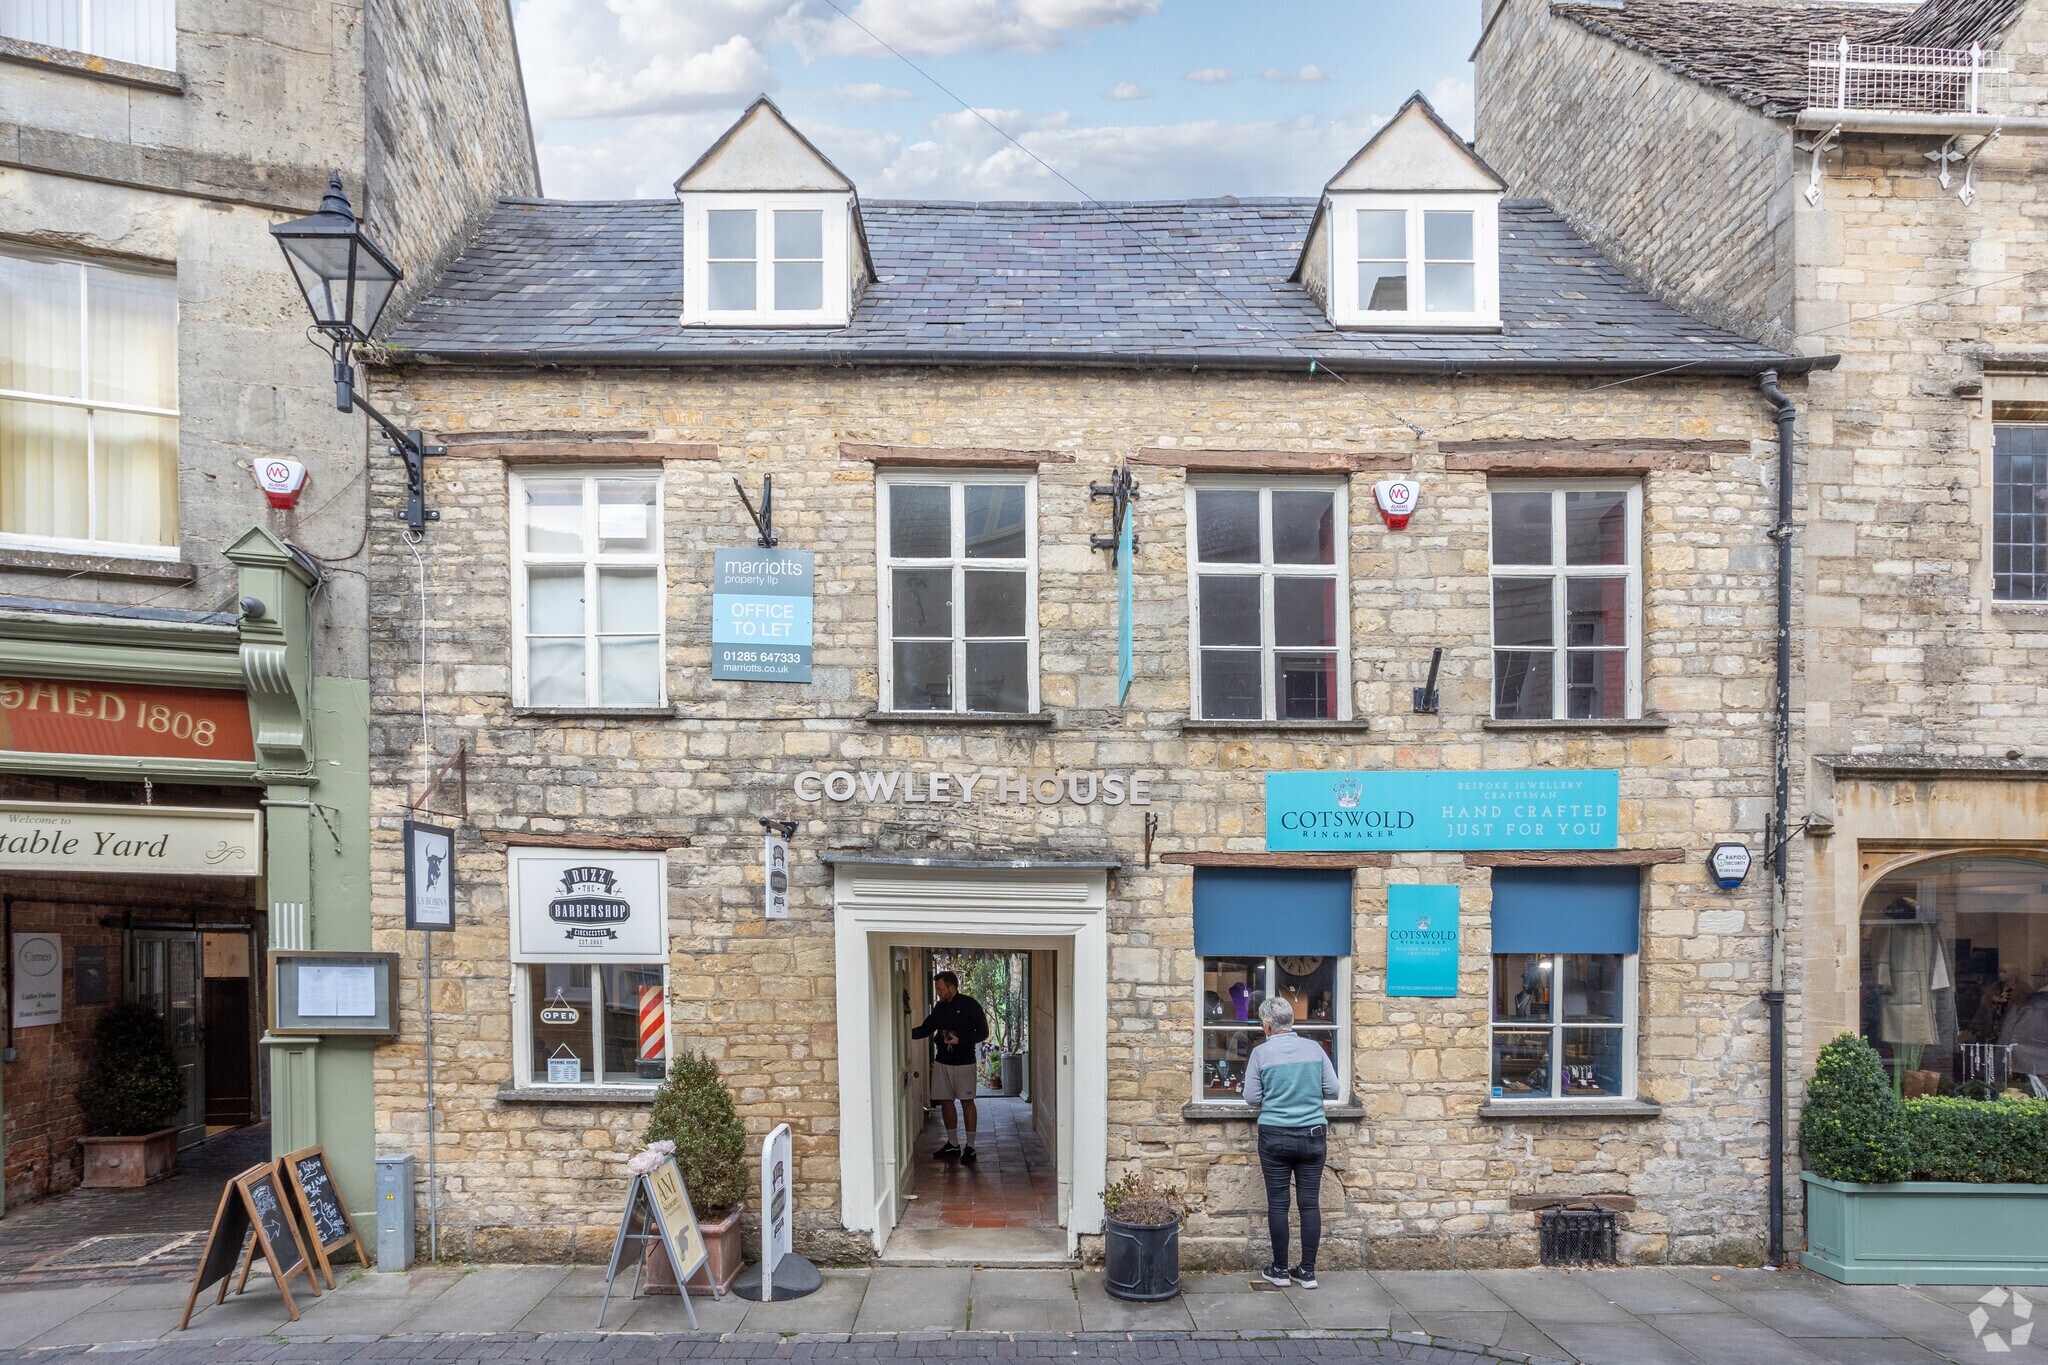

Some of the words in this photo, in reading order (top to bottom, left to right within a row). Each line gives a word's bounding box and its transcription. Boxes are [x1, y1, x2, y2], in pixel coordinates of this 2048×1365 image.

[725, 558, 803, 576] marriotts
[724, 575, 765, 586] property
[767, 575, 779, 586] llp
[731, 602, 795, 619] OFFICE
[732, 621, 756, 636] TO
[761, 622, 793, 637] LET
[723, 651, 757, 662] 01285
[760, 652, 801, 663] 647333
[723, 663, 789, 674] marriotts.co.uk
[0, 680, 127, 722] SHED
[136, 701, 218, 747] 1808
[793, 771, 983, 803] COWLEY
[999, 773, 1151, 806] HOUSE
[1458, 782, 1509, 790] BESPOKE
[1515, 781, 1583, 790] JEWELLERY
[1484, 791, 1557, 799] CRAFTSMAN
[1442, 805, 1501, 818] HAND
[1514, 805, 1607, 818] CRAFTED
[9, 814, 58, 825] Welcome
[60, 817, 72, 825] to
[1281, 810, 1415, 830] COTSWOLD
[1302, 830, 1394, 839] RINGMAKER
[1447, 823, 1493, 838] JUST
[1506, 823, 1544, 836] FOR
[1557, 823, 1601, 836] YOU
[0, 829, 79, 855] table
[92, 831, 169, 858] Yard
[571, 868, 607, 883] BUZZ
[554, 904, 626, 918] BARBERSHOP
[574, 929, 608, 937] CIRENCESTER
[1390, 930, 1456, 941] COTSWOLD
[24, 952, 52, 961] Cameo
[543, 1012, 577, 1020] OPEN
